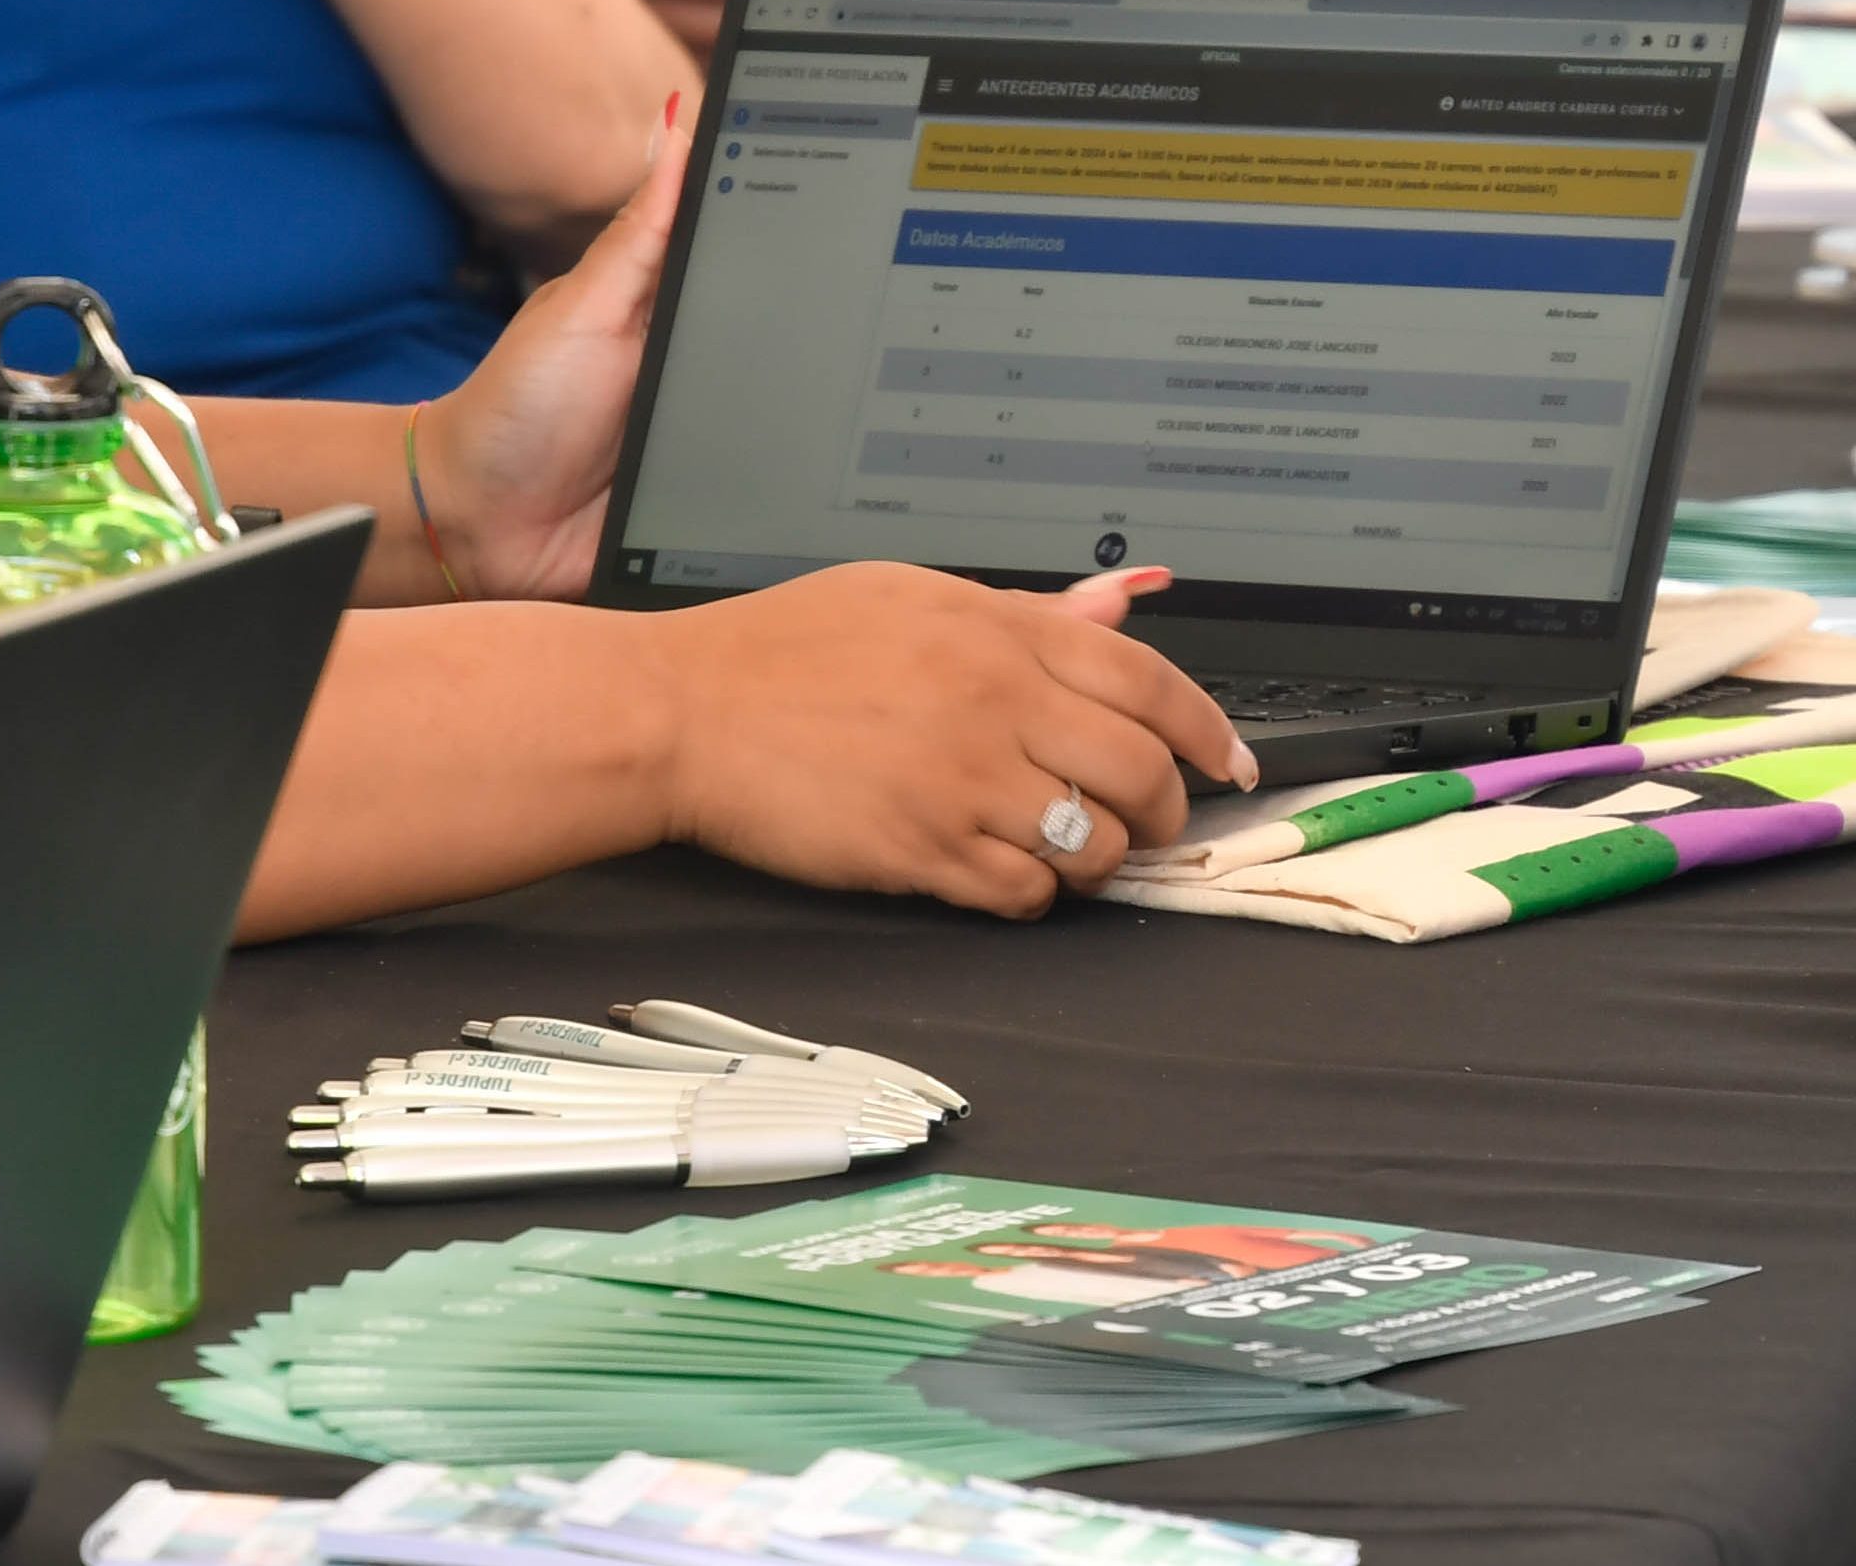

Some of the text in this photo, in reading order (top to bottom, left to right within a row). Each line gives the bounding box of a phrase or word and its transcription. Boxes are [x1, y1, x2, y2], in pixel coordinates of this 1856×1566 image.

[977, 79, 1200, 101] ANTECEDENTES ACADÉMICOS
[909, 228, 1066, 252] Datos Académicos
[1315, 340, 1379, 354] LANCASTER
[1296, 426, 1360, 440] LANCASTER
[520, 1020, 607, 1048] TUPUEDEScl
[448, 1052, 552, 1075] TUPUEDEScl
[405, 1072, 513, 1092] TUPUEDEScl
[1185, 1290, 1312, 1319] 02
[1350, 1252, 1471, 1283] 03
[1260, 1263, 1549, 1331] ENERO
